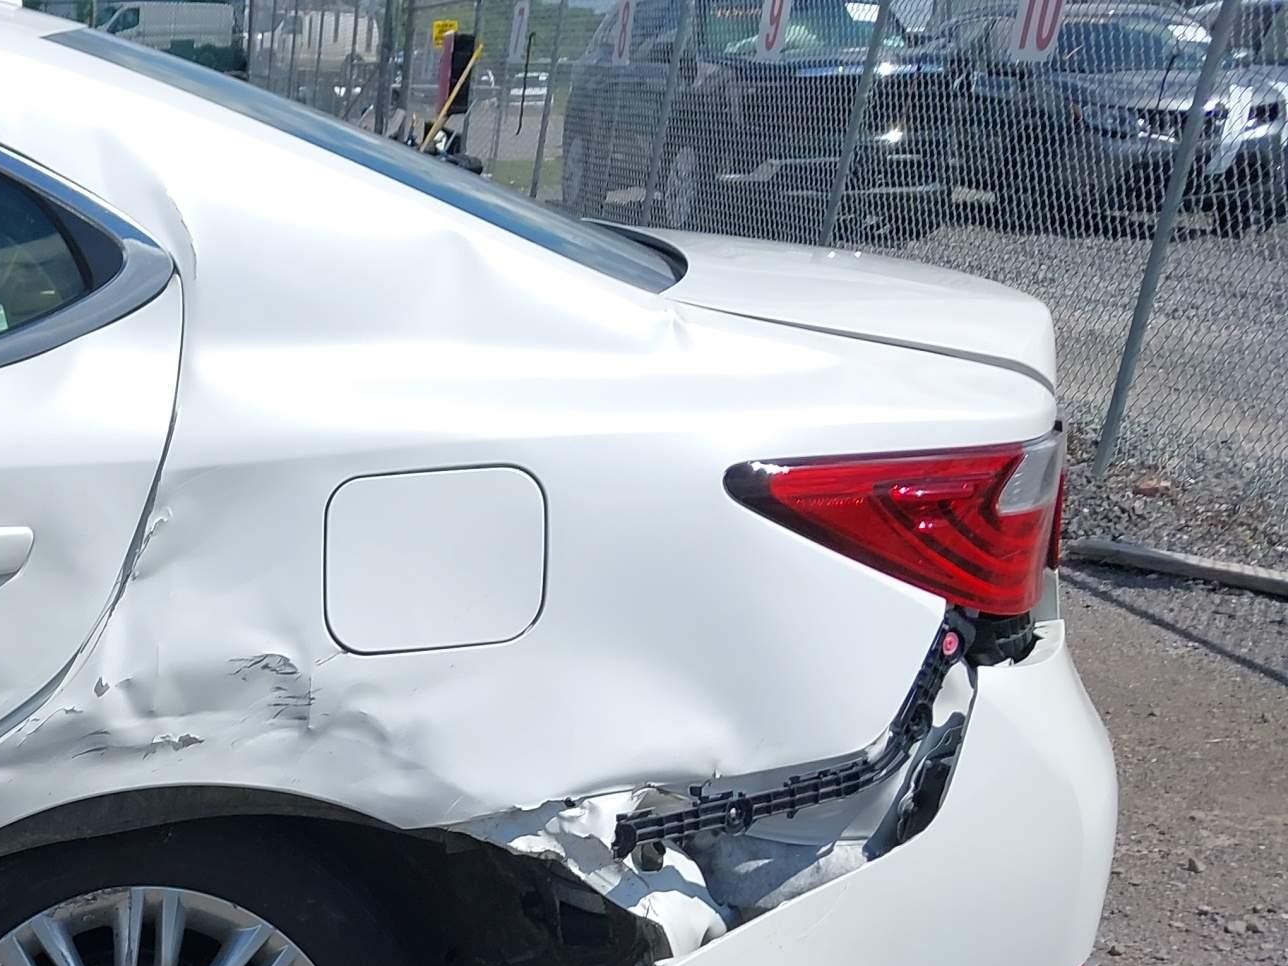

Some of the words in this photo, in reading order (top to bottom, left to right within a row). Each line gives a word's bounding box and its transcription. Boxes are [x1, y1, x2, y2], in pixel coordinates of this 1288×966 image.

[617, 0, 631, 58] 8
[765, 0, 784, 51] 9
[1018, 0, 1063, 50] 10
